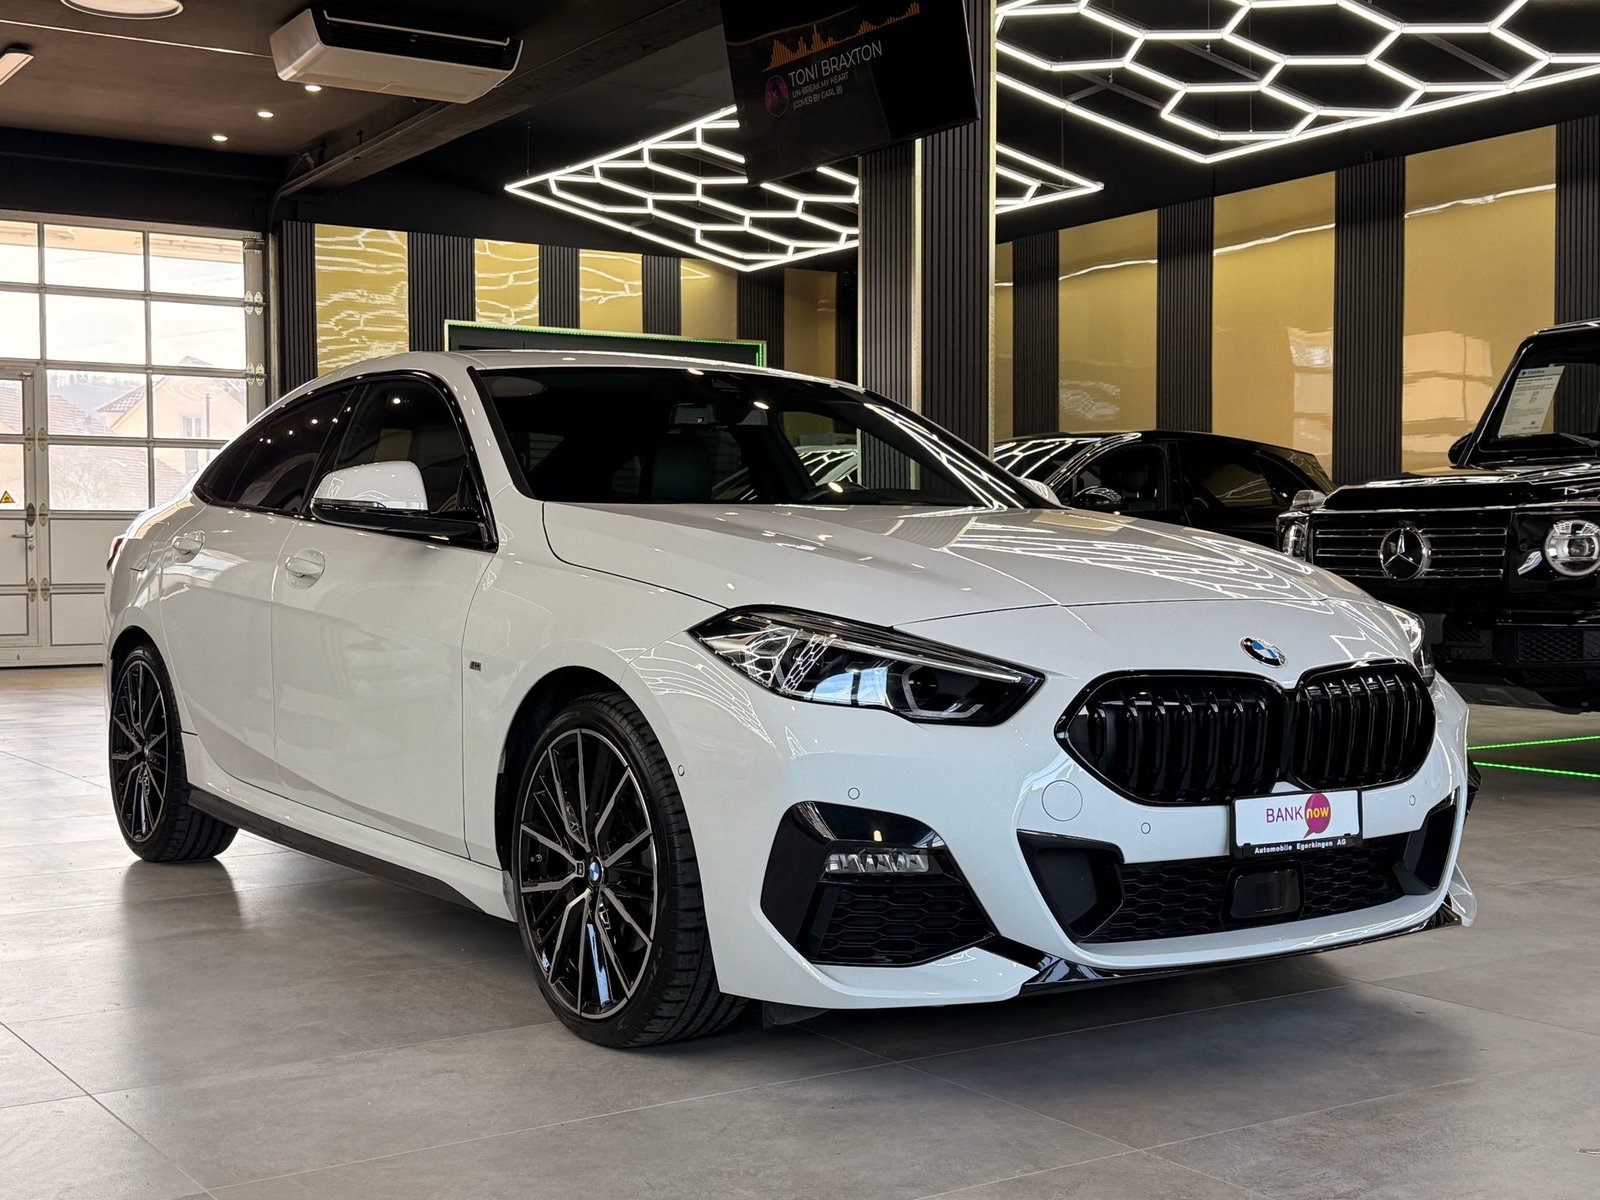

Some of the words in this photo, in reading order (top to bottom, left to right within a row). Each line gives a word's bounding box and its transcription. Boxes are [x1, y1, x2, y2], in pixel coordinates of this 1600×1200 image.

[788, 63, 818, 87] TONI
[821, 40, 883, 76] BRAXTON
[793, 82, 820, 98] UN-BREAK
[821, 80, 829, 88] MY
[830, 72, 849, 85] HEART
[813, 94, 820, 102] BY
[821, 89, 836, 99] CARL
[1266, 806, 1303, 823] BANK
[1306, 807, 1329, 819] now
[1254, 844, 1292, 854] Automobile
